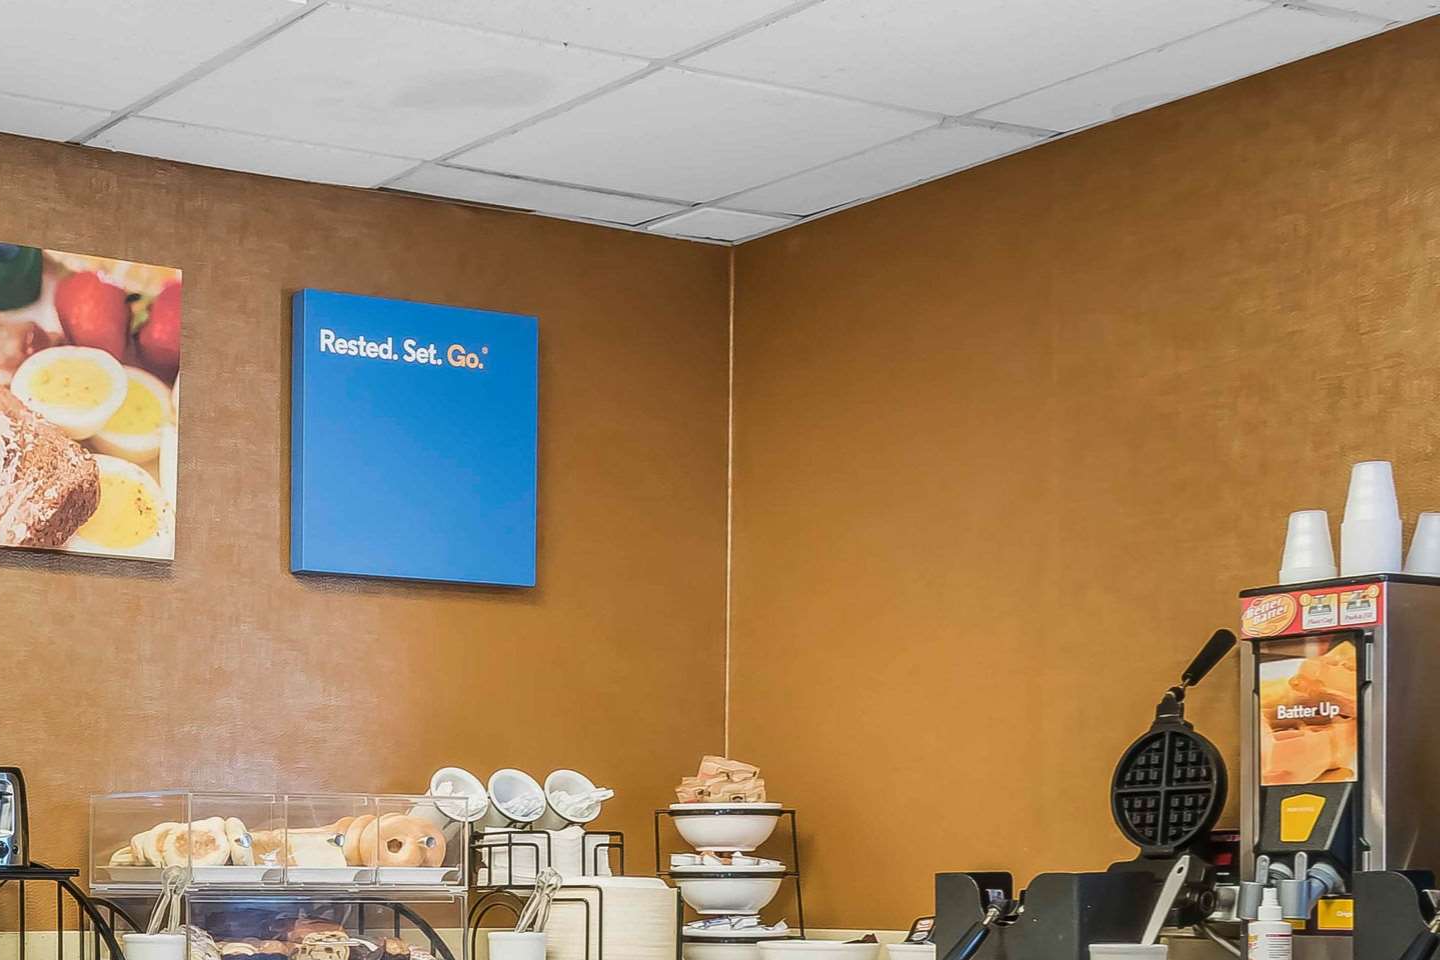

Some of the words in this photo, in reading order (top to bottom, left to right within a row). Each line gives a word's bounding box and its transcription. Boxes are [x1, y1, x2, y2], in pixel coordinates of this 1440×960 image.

[319, 328, 399, 361] Rested.
[402, 338, 443, 366] Set.
[1277, 704, 1318, 720] Batter
[1319, 701, 1340, 719] Up
